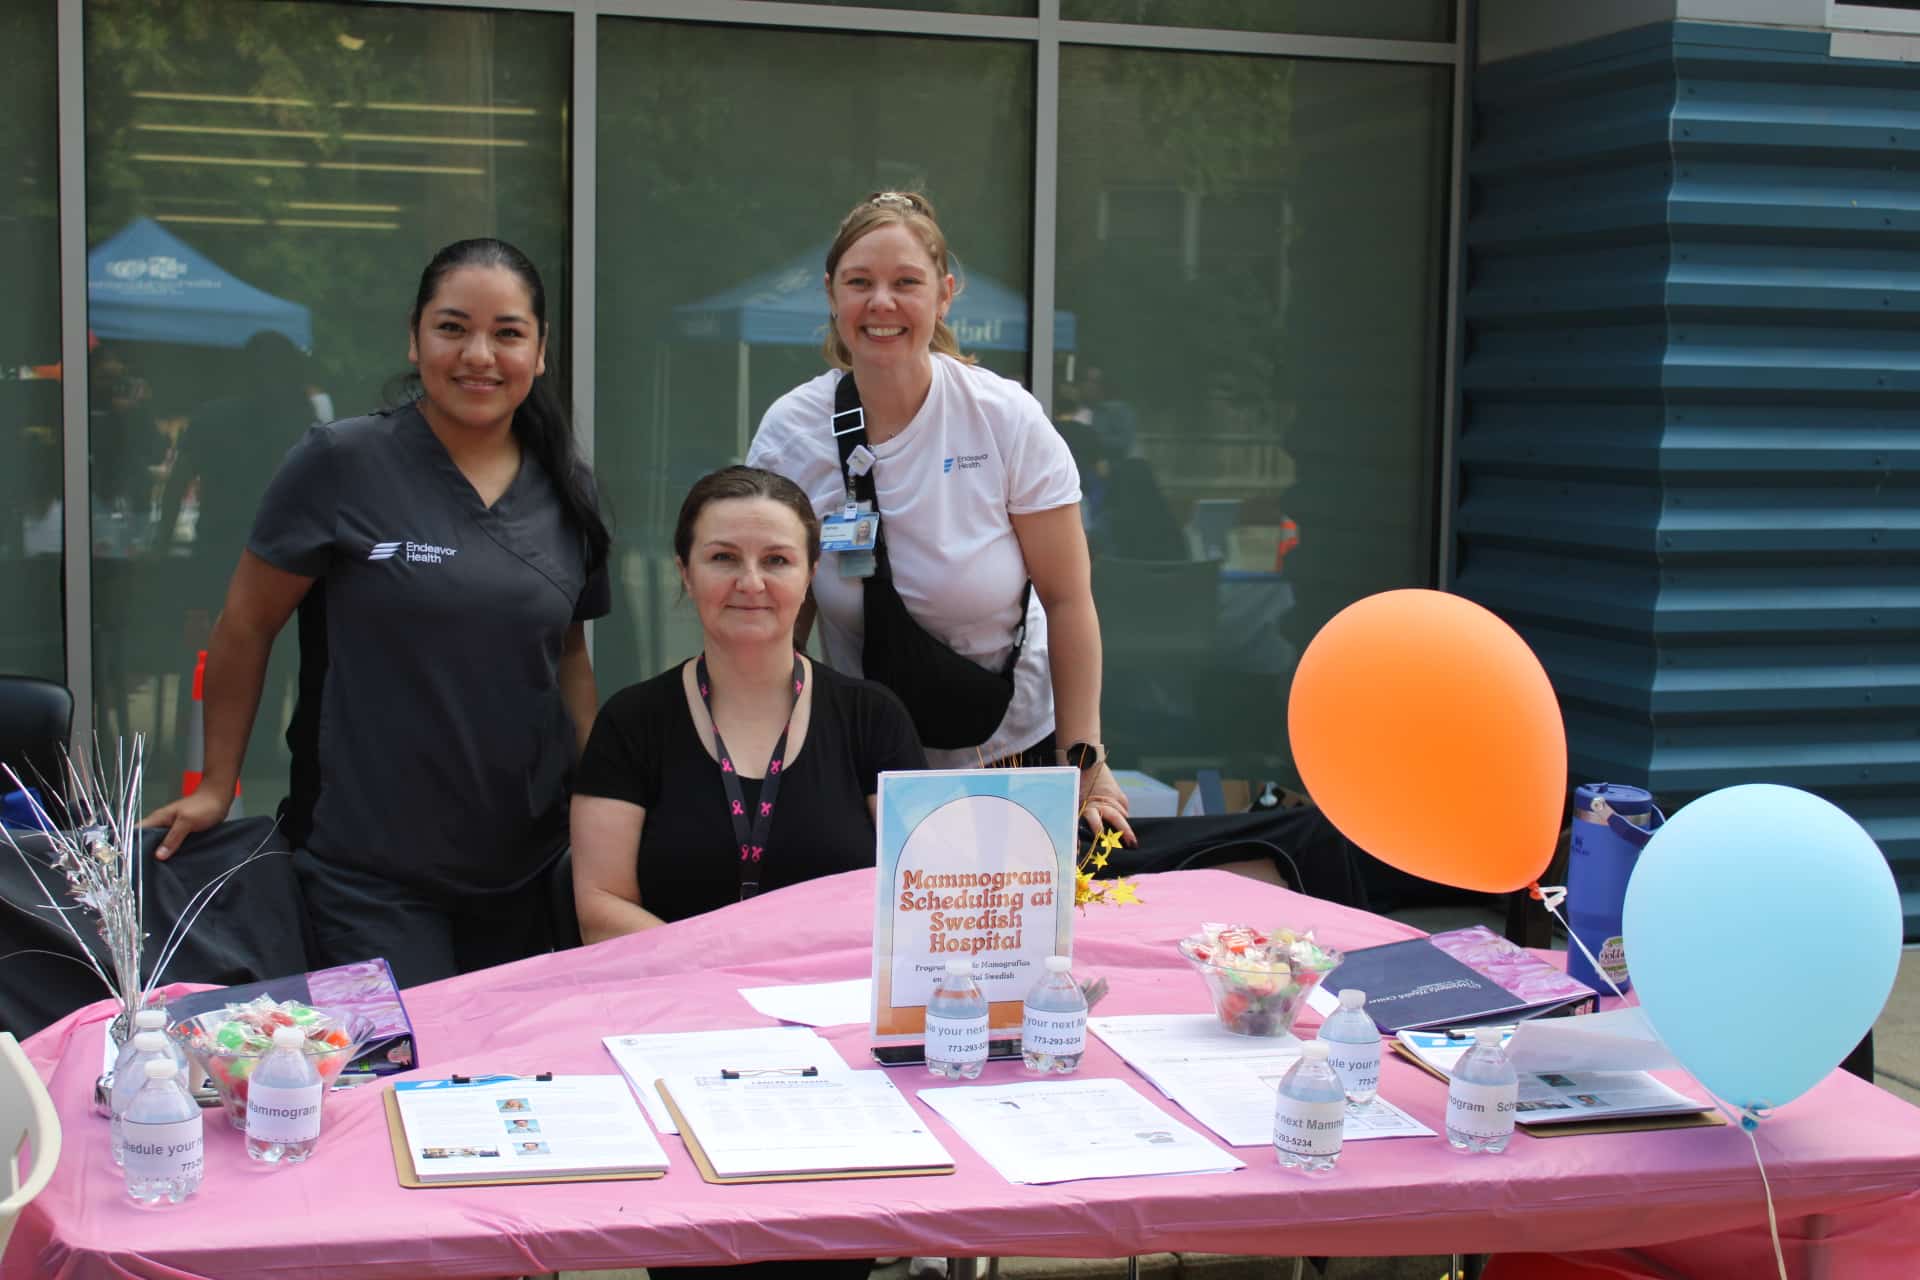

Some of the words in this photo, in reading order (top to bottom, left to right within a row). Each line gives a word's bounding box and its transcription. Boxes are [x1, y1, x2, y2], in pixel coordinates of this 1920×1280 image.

[958, 461, 981, 471] Health
[406, 541, 457, 556] Endeavor
[406, 551, 442, 563] Health
[902, 869, 1052, 892] Mammogram
[899, 886, 1024, 911] Scheduling
[1030, 887, 1054, 907] at
[929, 907, 1023, 932] Swedish
[929, 930, 1022, 955] Hospital
[984, 971, 1015, 981] Swedish
[1026, 1017, 1048, 1028] your
[1051, 1020, 1075, 1030] next
[937, 1025, 962, 1037] your
[1032, 1035, 1081, 1046] 773-293-5234
[948, 1042, 985, 1053] 773-293-52
[1347, 1060, 1373, 1072] your
[1280, 1115, 1303, 1129] next
[167, 1140, 197, 1157] your
